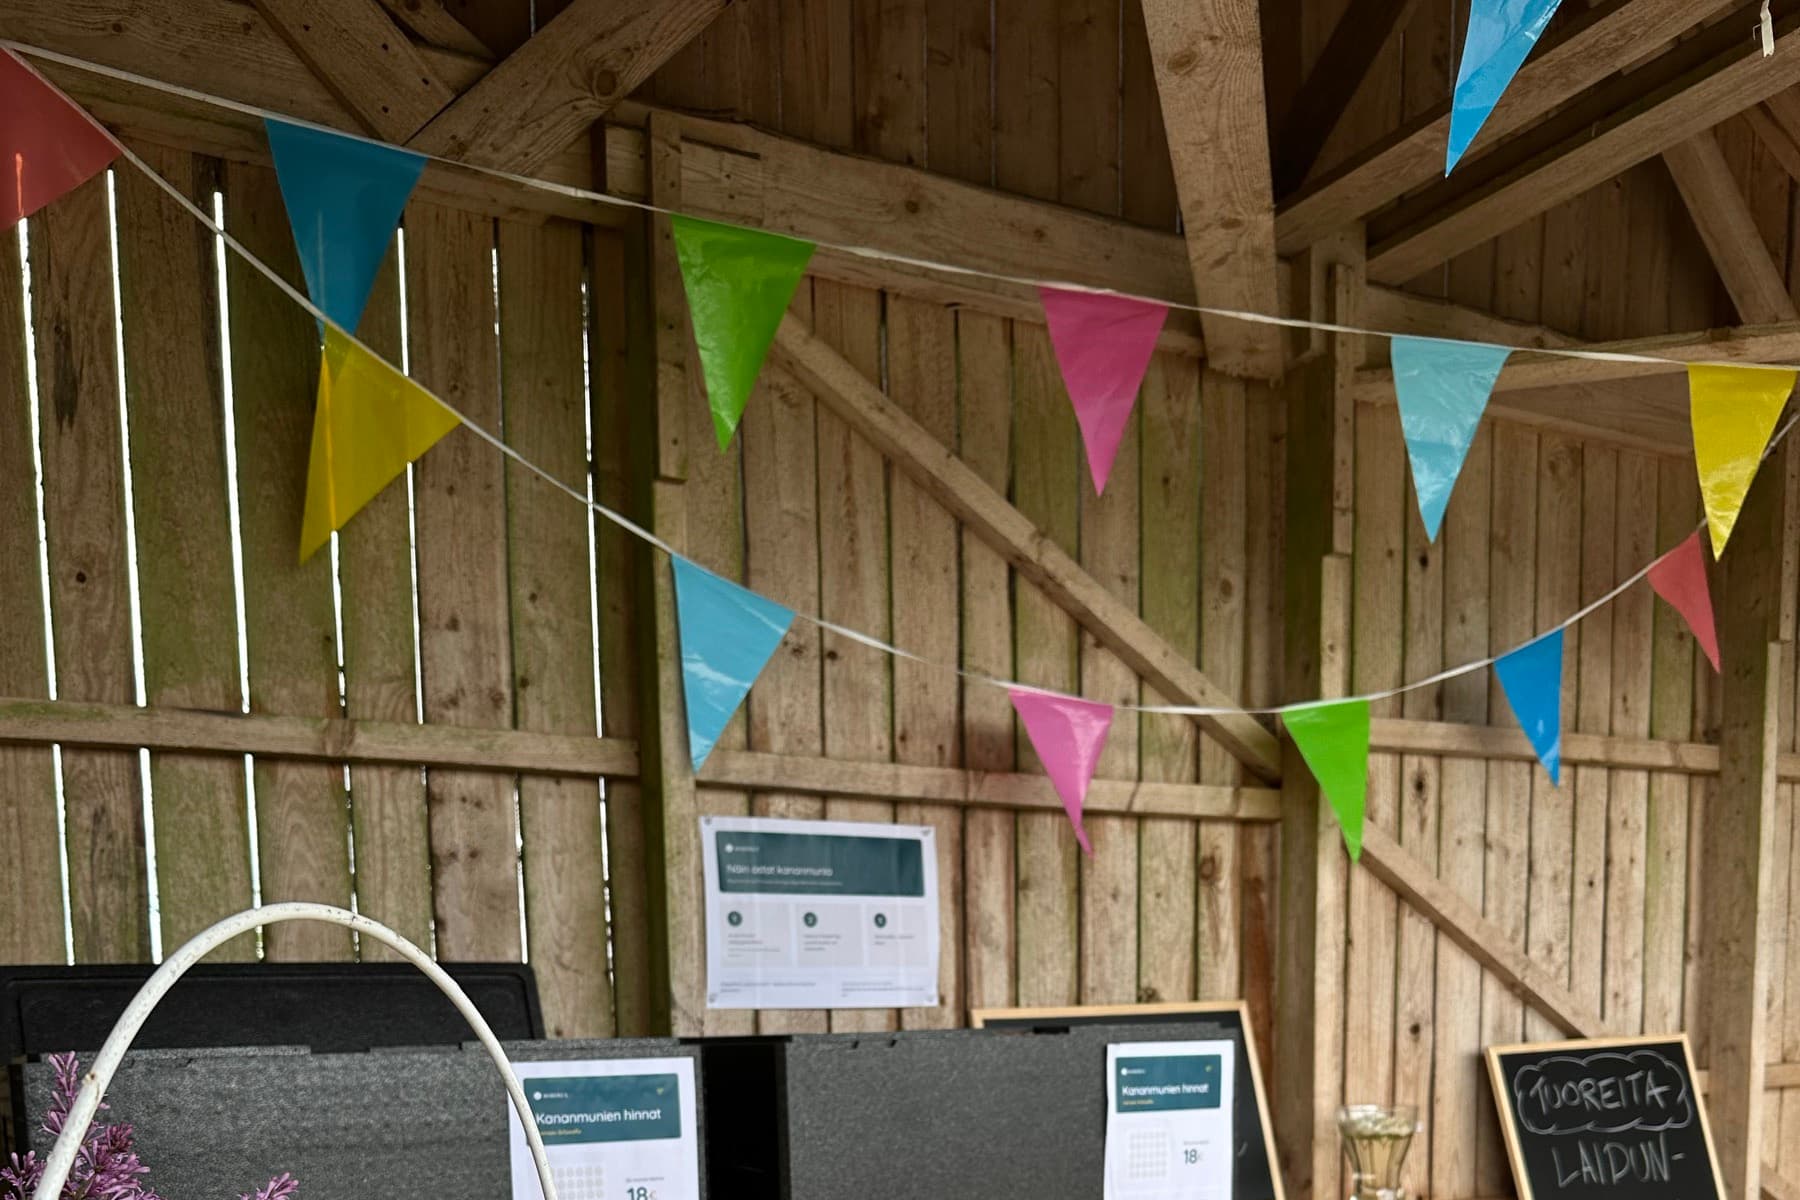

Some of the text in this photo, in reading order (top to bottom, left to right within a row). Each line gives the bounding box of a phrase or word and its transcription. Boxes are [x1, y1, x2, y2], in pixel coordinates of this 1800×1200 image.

[1121, 1082, 1209, 1097] Kananmunien hinnat
[1530, 1072, 1671, 1115] TUOREITA
[535, 1108, 661, 1125] Kananmunien hinnat
[1551, 1133, 1685, 1188] LAIDUN-
